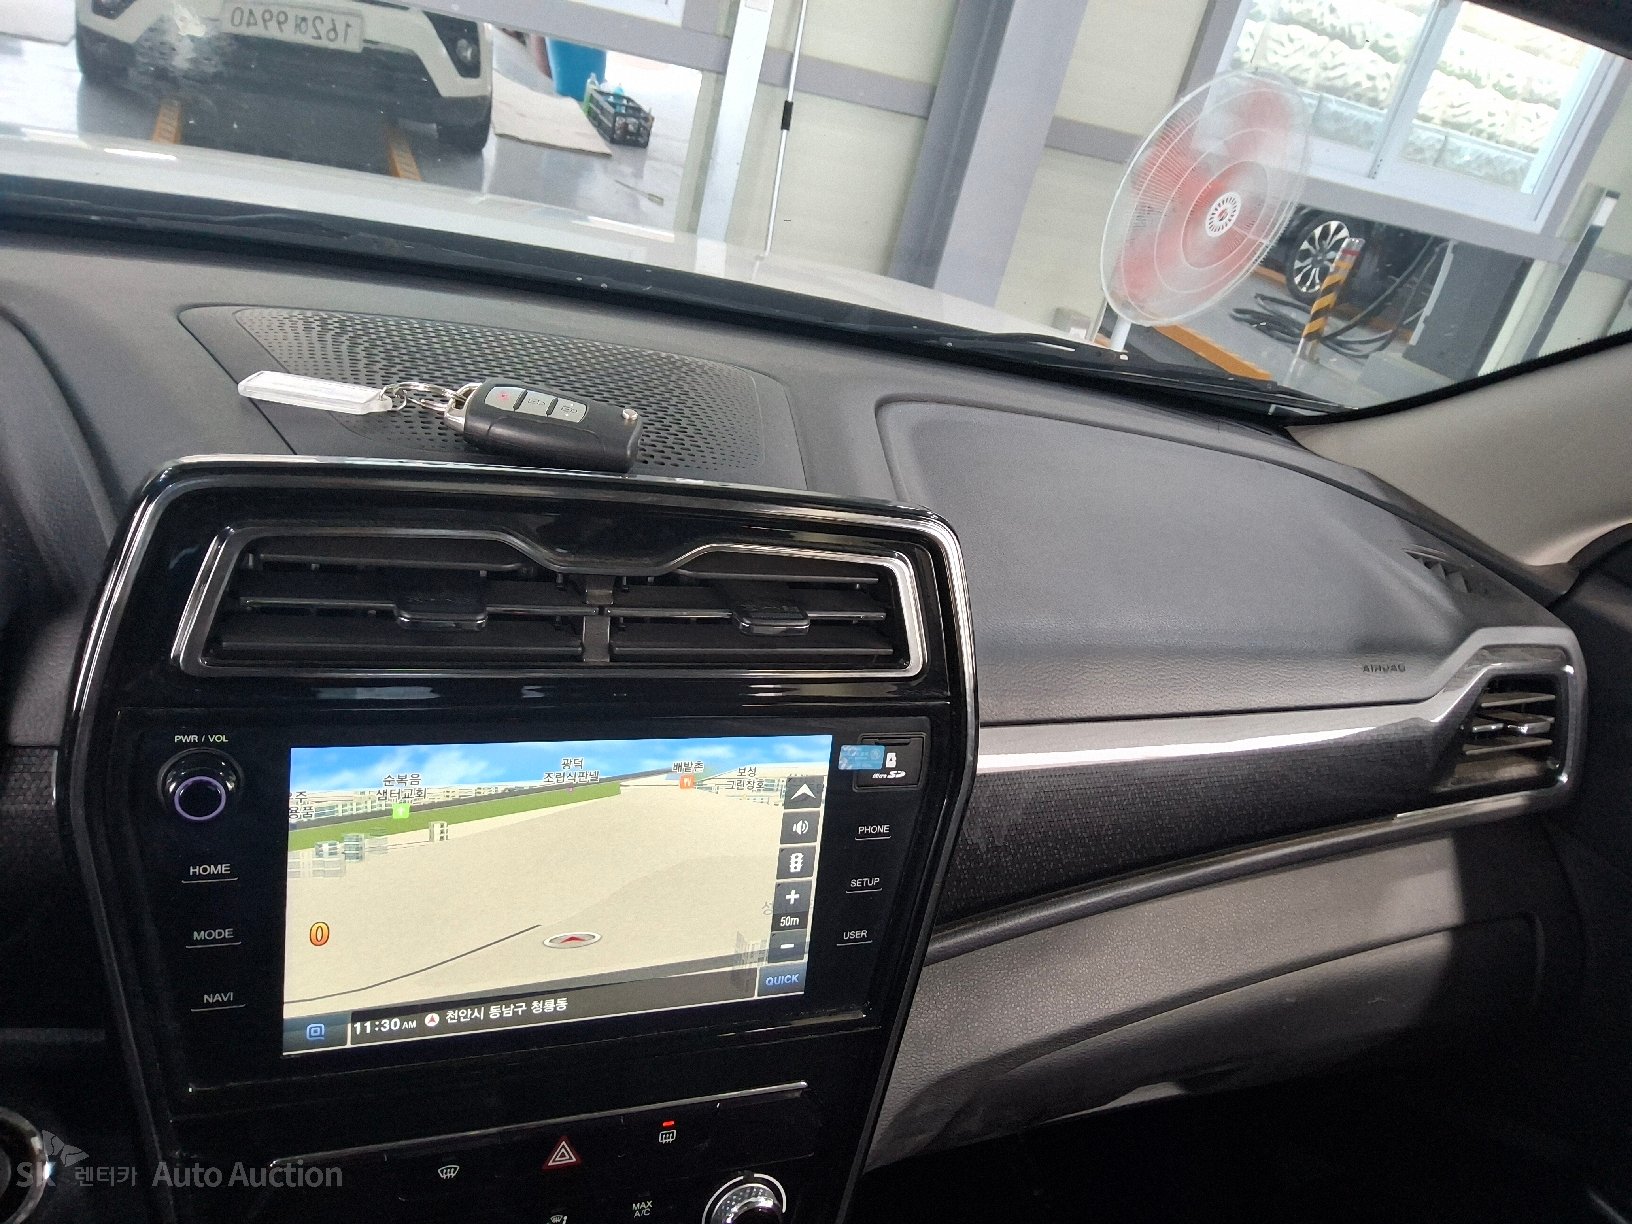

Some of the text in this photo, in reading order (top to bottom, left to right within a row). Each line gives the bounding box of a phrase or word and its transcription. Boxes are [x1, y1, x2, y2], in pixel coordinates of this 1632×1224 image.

[174, 734, 199, 743] PWR
[208, 734, 229, 743] VOL
[561, 758, 584, 770] 광덕
[736, 766, 757, 777] 보성
[382, 773, 422, 787] 순복음
[376, 787, 427, 801] 샘터교회
[858, 825, 890, 834] PHONE
[189, 863, 231, 876] HOME
[850, 877, 880, 887] SETUP
[780, 915, 800, 927] 50m
[193, 928, 234, 941] MODE
[309, 921, 330, 947] 0
[843, 930, 868, 940] USER
[765, 974, 799, 987] QUICK
[203, 992, 234, 1004] NAVI
[445, 1006, 485, 1024] 천안시
[489, 1002, 527, 1019] 동남구
[353, 1017, 417, 1035] 11:30 AM
[632, 1200, 653, 1211] MAX
[633, 1208, 651, 1219] A/C
